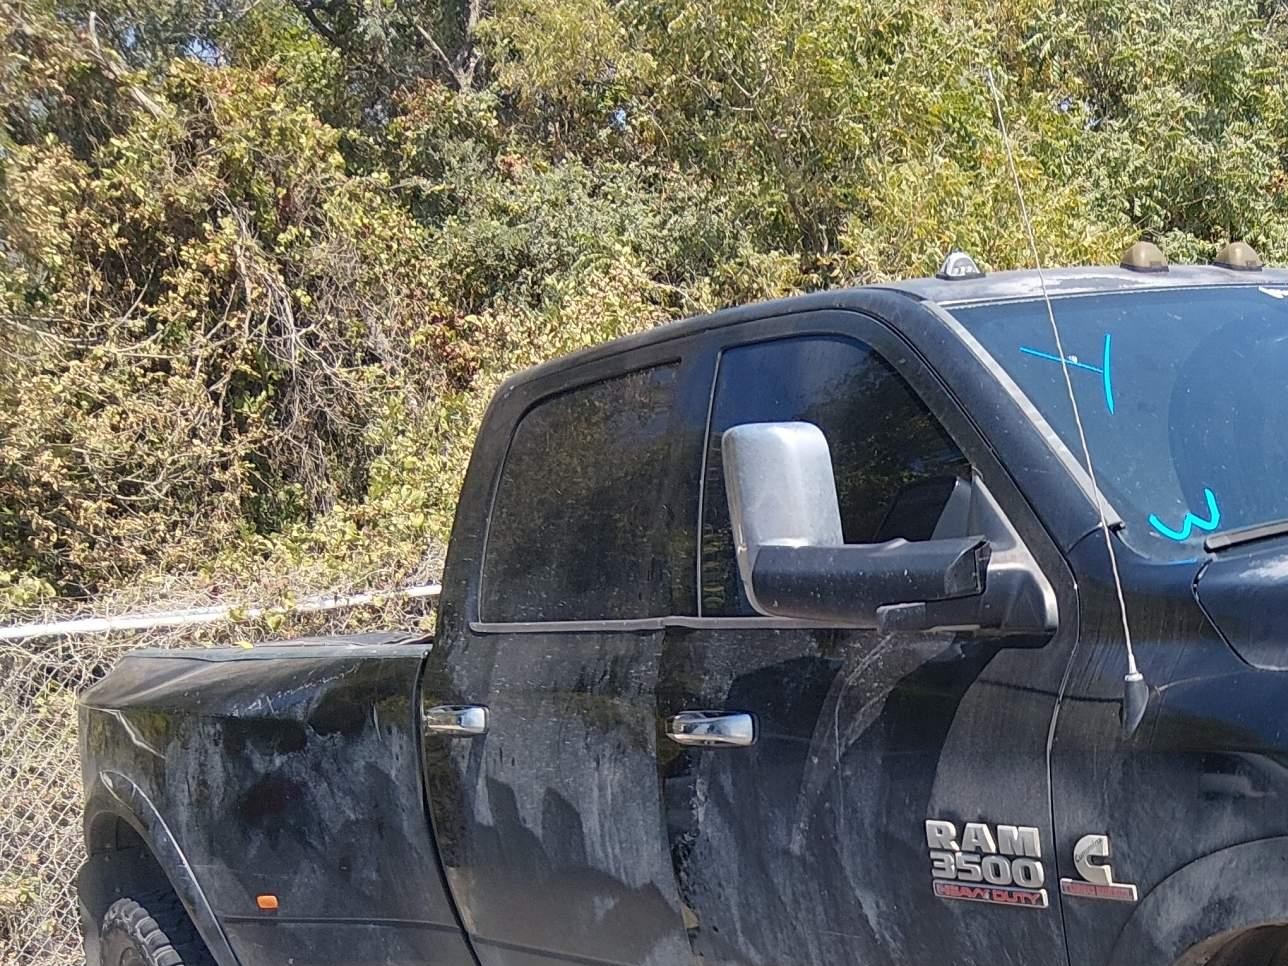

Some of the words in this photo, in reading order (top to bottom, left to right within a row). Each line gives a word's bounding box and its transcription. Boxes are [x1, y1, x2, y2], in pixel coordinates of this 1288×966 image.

[925, 819, 1042, 858] RAM
[929, 850, 1045, 889] 3500
[991, 889, 1041, 906] DUTY
